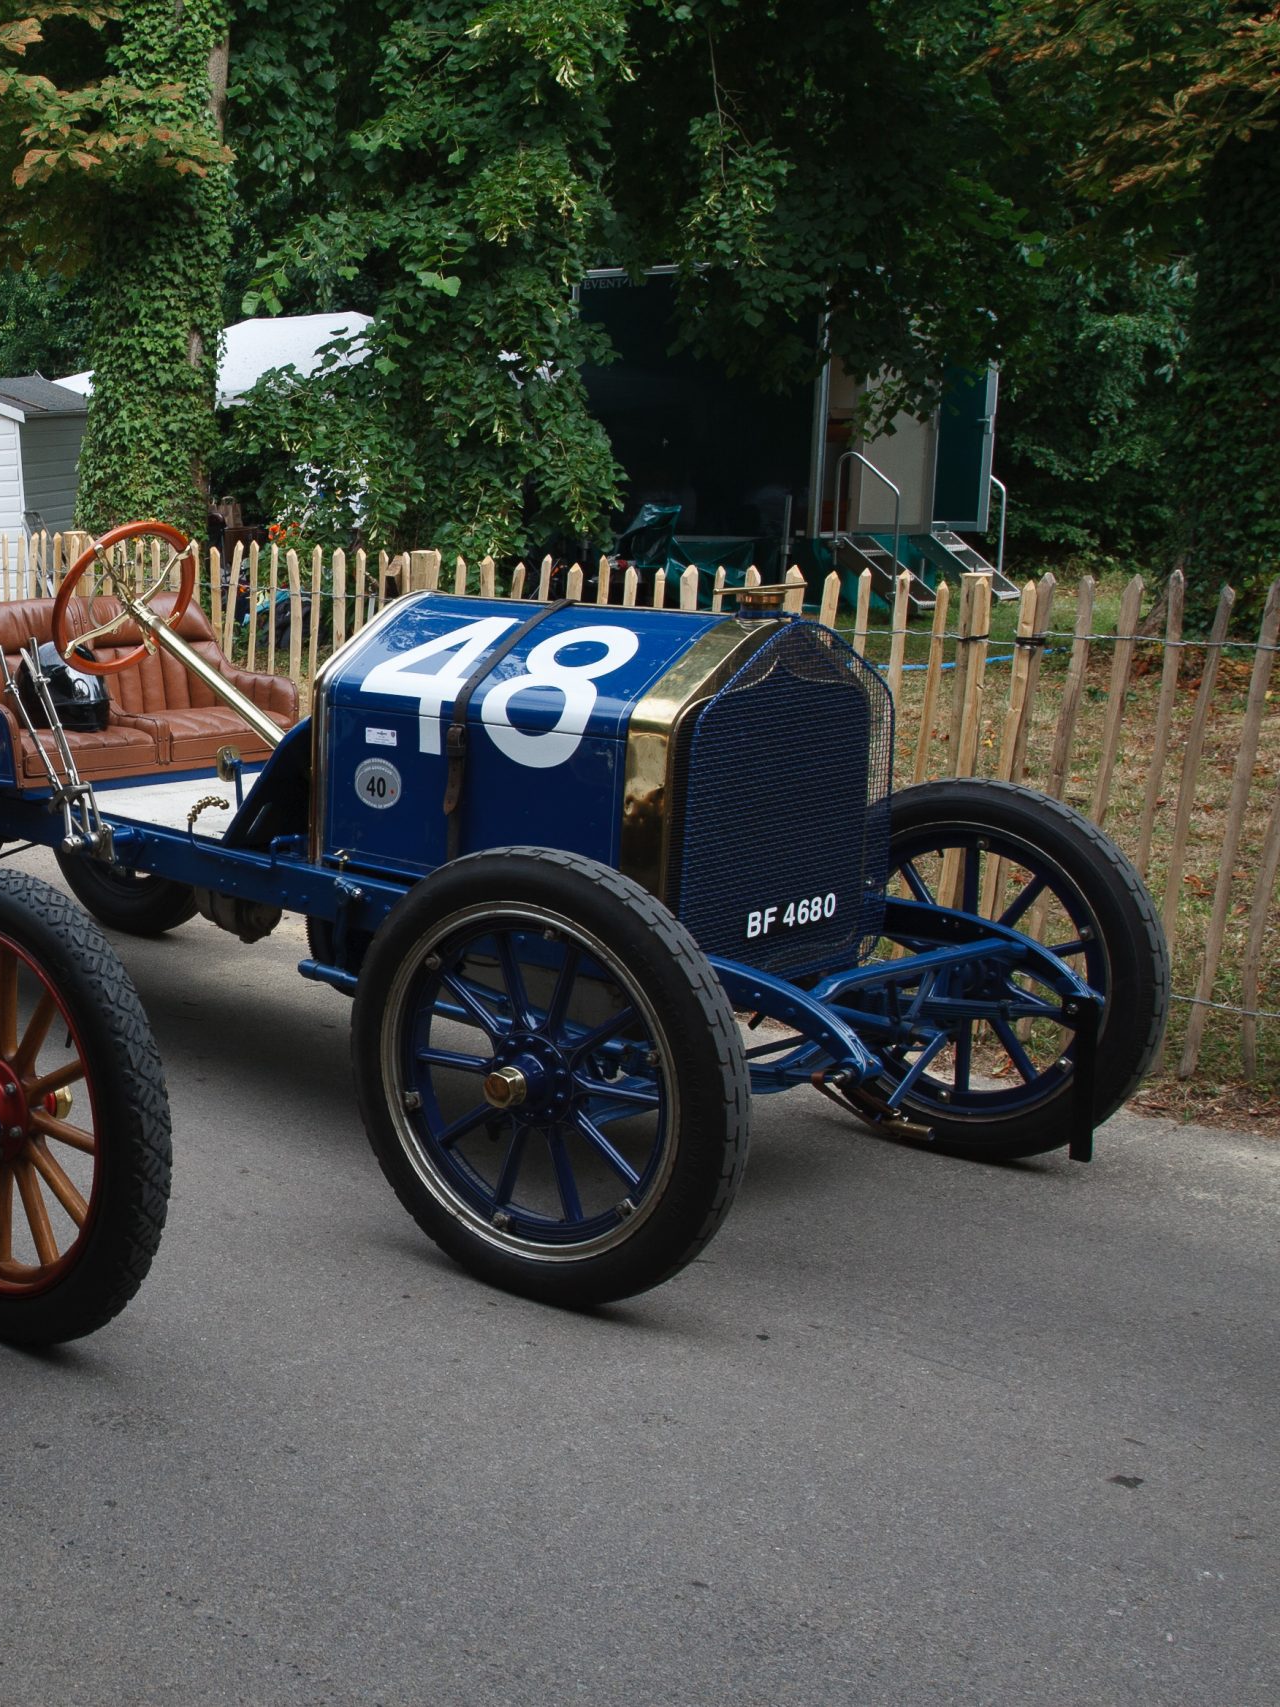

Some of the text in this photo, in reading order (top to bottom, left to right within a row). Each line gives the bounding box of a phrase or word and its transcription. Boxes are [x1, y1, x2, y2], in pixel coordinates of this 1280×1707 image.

[360, 616, 639, 768] 48
[366, 776, 386, 798] 40
[747, 892, 836, 939] BF 4680
